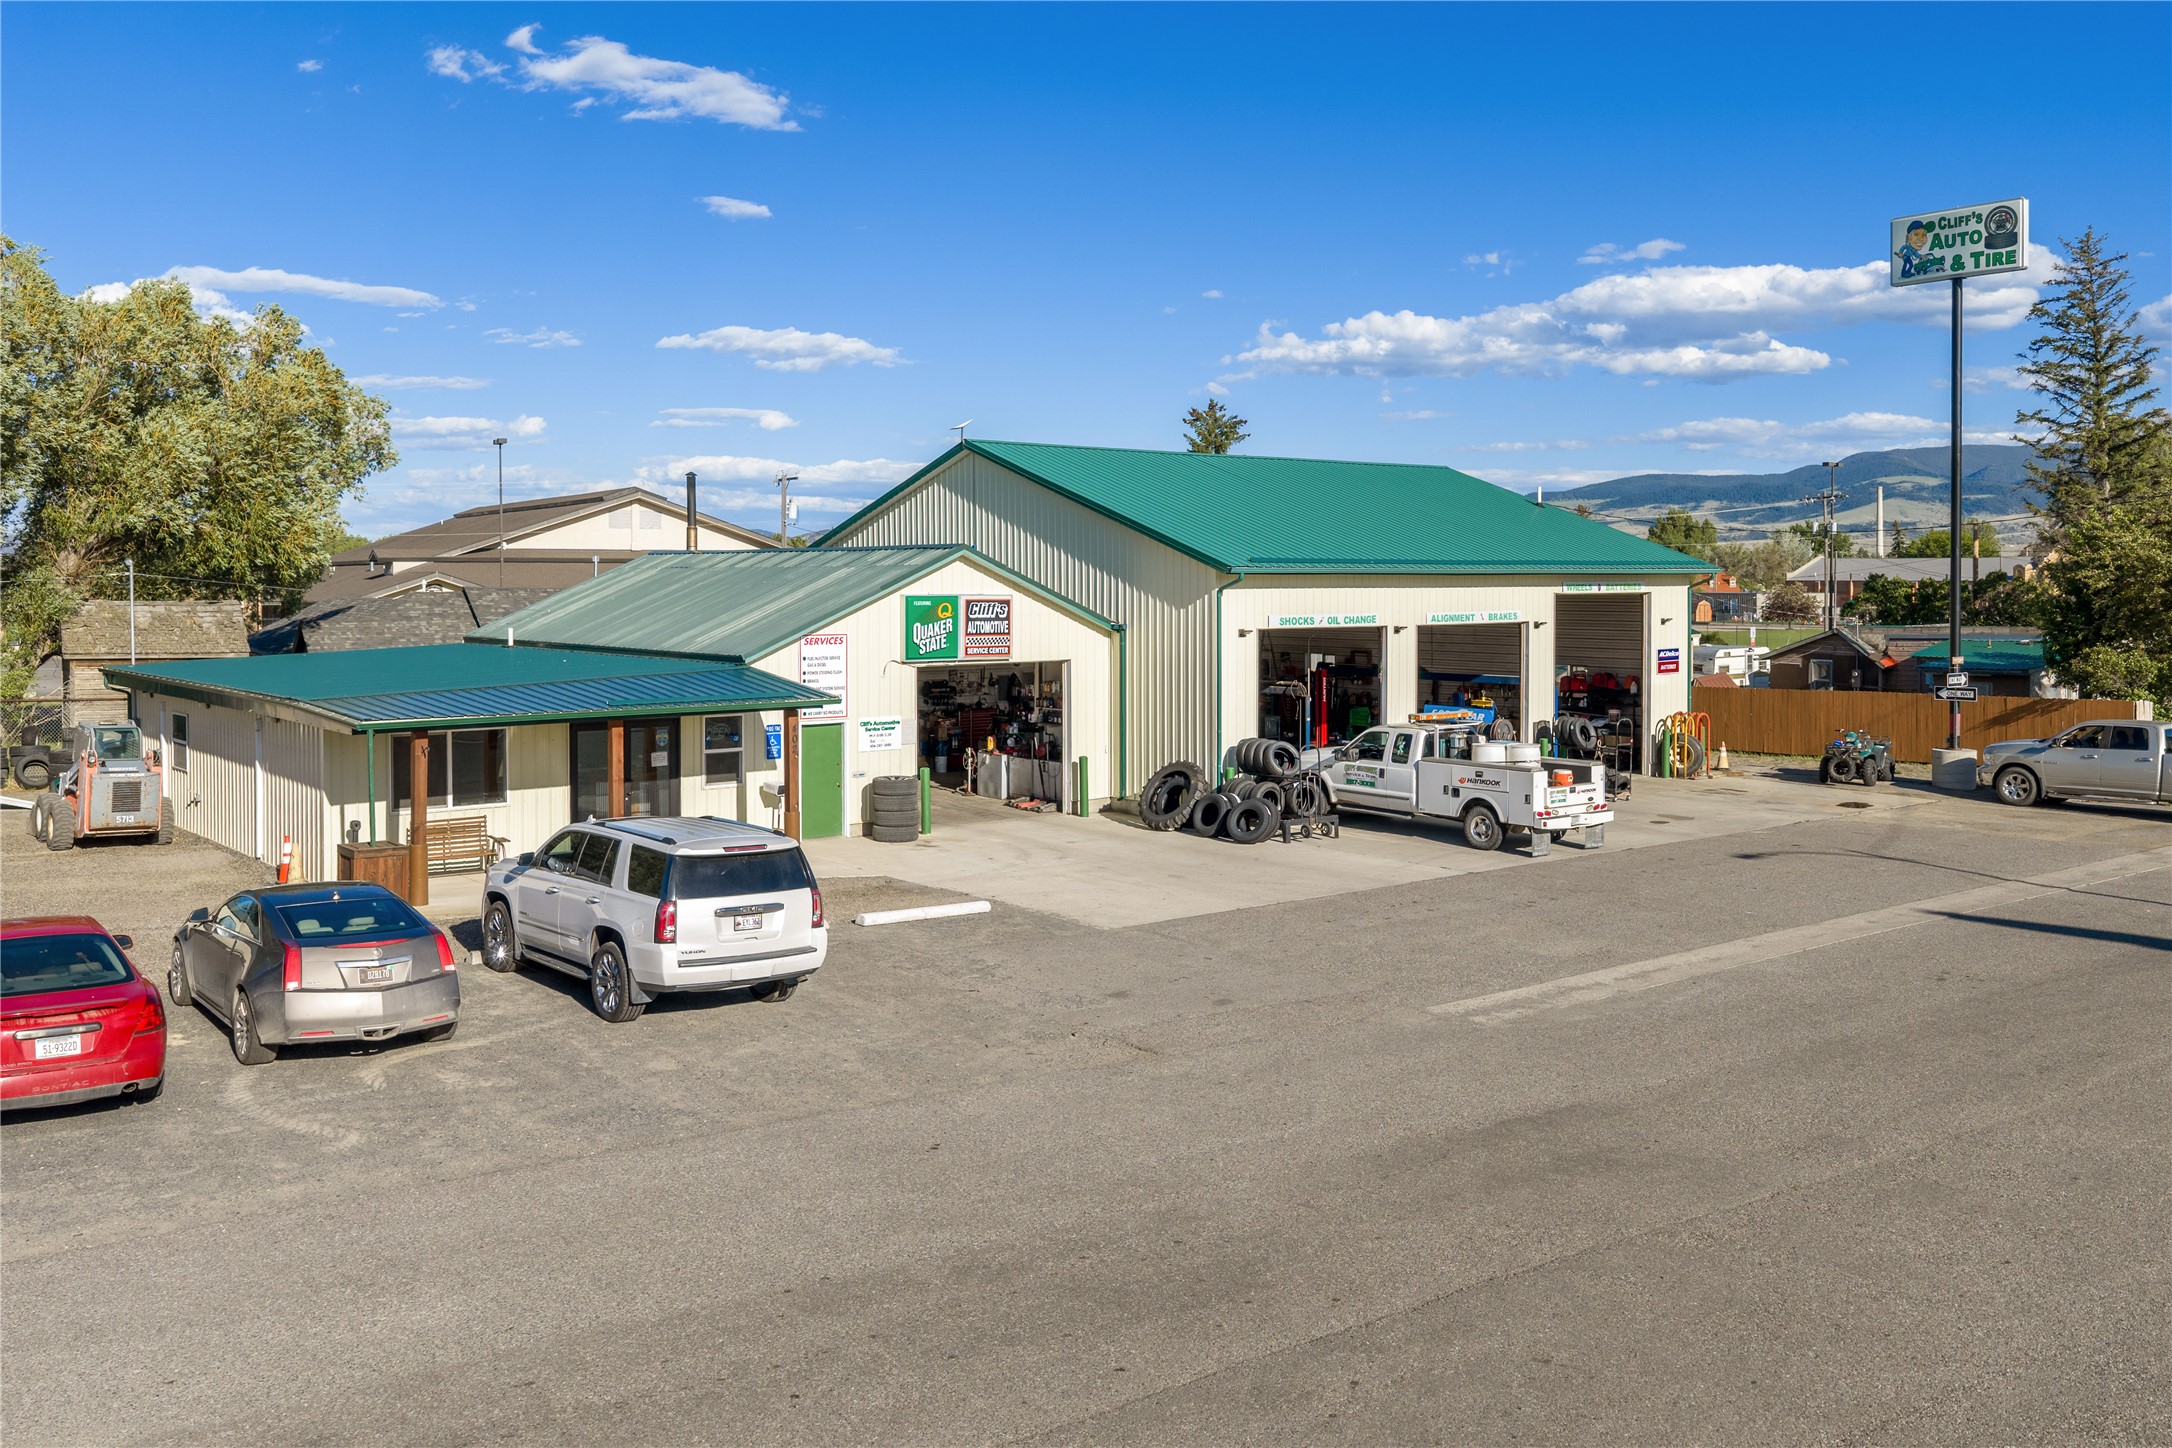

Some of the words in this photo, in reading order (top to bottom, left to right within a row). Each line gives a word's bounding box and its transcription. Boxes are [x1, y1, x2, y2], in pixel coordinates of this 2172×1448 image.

[1938, 212, 1983, 230] CLIFF'S
[1929, 230, 1983, 251] AUTO
[1950, 254, 1966, 272] &
[1970, 250, 2017, 269] TIRE
[1567, 583, 1593, 591] WHEELS
[1606, 583, 1642, 591] BATTERIES
[968, 602, 1008, 618] Cliff's
[1431, 614, 1475, 622] ALIGNMENT
[1488, 612, 1518, 620] BRAKES
[967, 621, 1009, 634] AUTOMOTIVE
[1279, 617, 1315, 626] SHOCKS
[1327, 616, 1340, 625] OIL
[1343, 615, 1376, 624] CHANGE
[913, 618, 953, 645] QUAKER
[804, 636, 844, 645] SERVICES
[919, 634, 947, 655] STATE
[32, 1080, 89, 1092] PONTIAC
